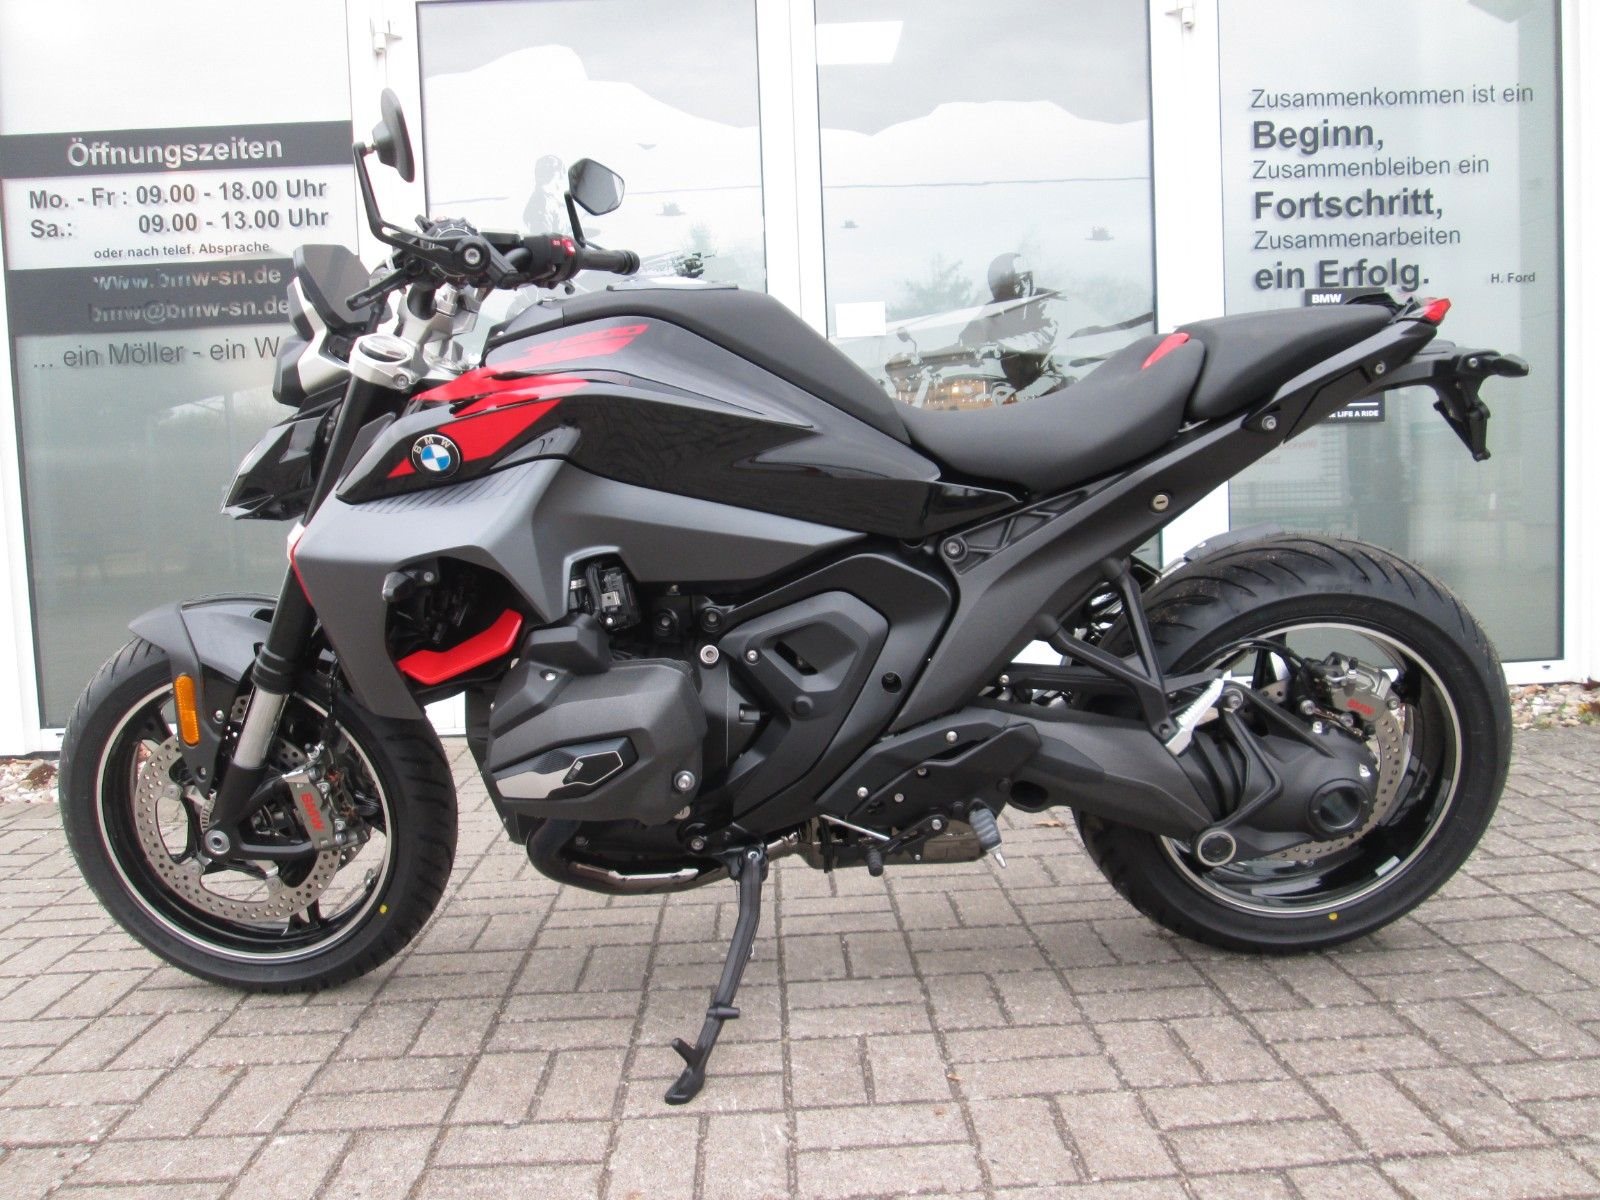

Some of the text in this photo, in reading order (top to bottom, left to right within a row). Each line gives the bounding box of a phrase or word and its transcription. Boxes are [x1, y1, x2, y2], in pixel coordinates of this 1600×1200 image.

[1251, 83, 1534, 109] Zusammenkommen ist ein
[1253, 118, 1384, 155] Beginn,
[67, 137, 283, 168] Öffnungszeiten
[1252, 154, 1490, 180] Zusammenbleiben ein
[29, 189, 70, 210] Mo.
[136, 184, 196, 205] 09.00
[218, 180, 279, 202] 18.00
[286, 179, 328, 199] Uhr
[1255, 187, 1443, 220] Fortschritt,
[30, 218, 74, 239] Sa.:
[138, 212, 198, 234] 09.00
[221, 209, 281, 231] 13.00
[288, 208, 330, 228] Uhr
[94, 247, 124, 260] oder
[127, 245, 159, 258] nach
[199, 241, 270, 257] Absprache
[1254, 226, 1461, 250] Zusammenarbeiten
[1255, 257, 1430, 292] ein Erfolg.
[1490, 272, 1536, 284] H. Ford
[1311, 293, 1342, 304] BMW
[63, 346, 99, 368] ein
[109, 341, 184, 367] Möller
[210, 338, 246, 360] ein
[1337, 410, 1353, 418] LIFE
[1361, 409, 1379, 417] RIDE
[412, 436, 451, 455] BMW
[301, 792, 324, 831] BMW
